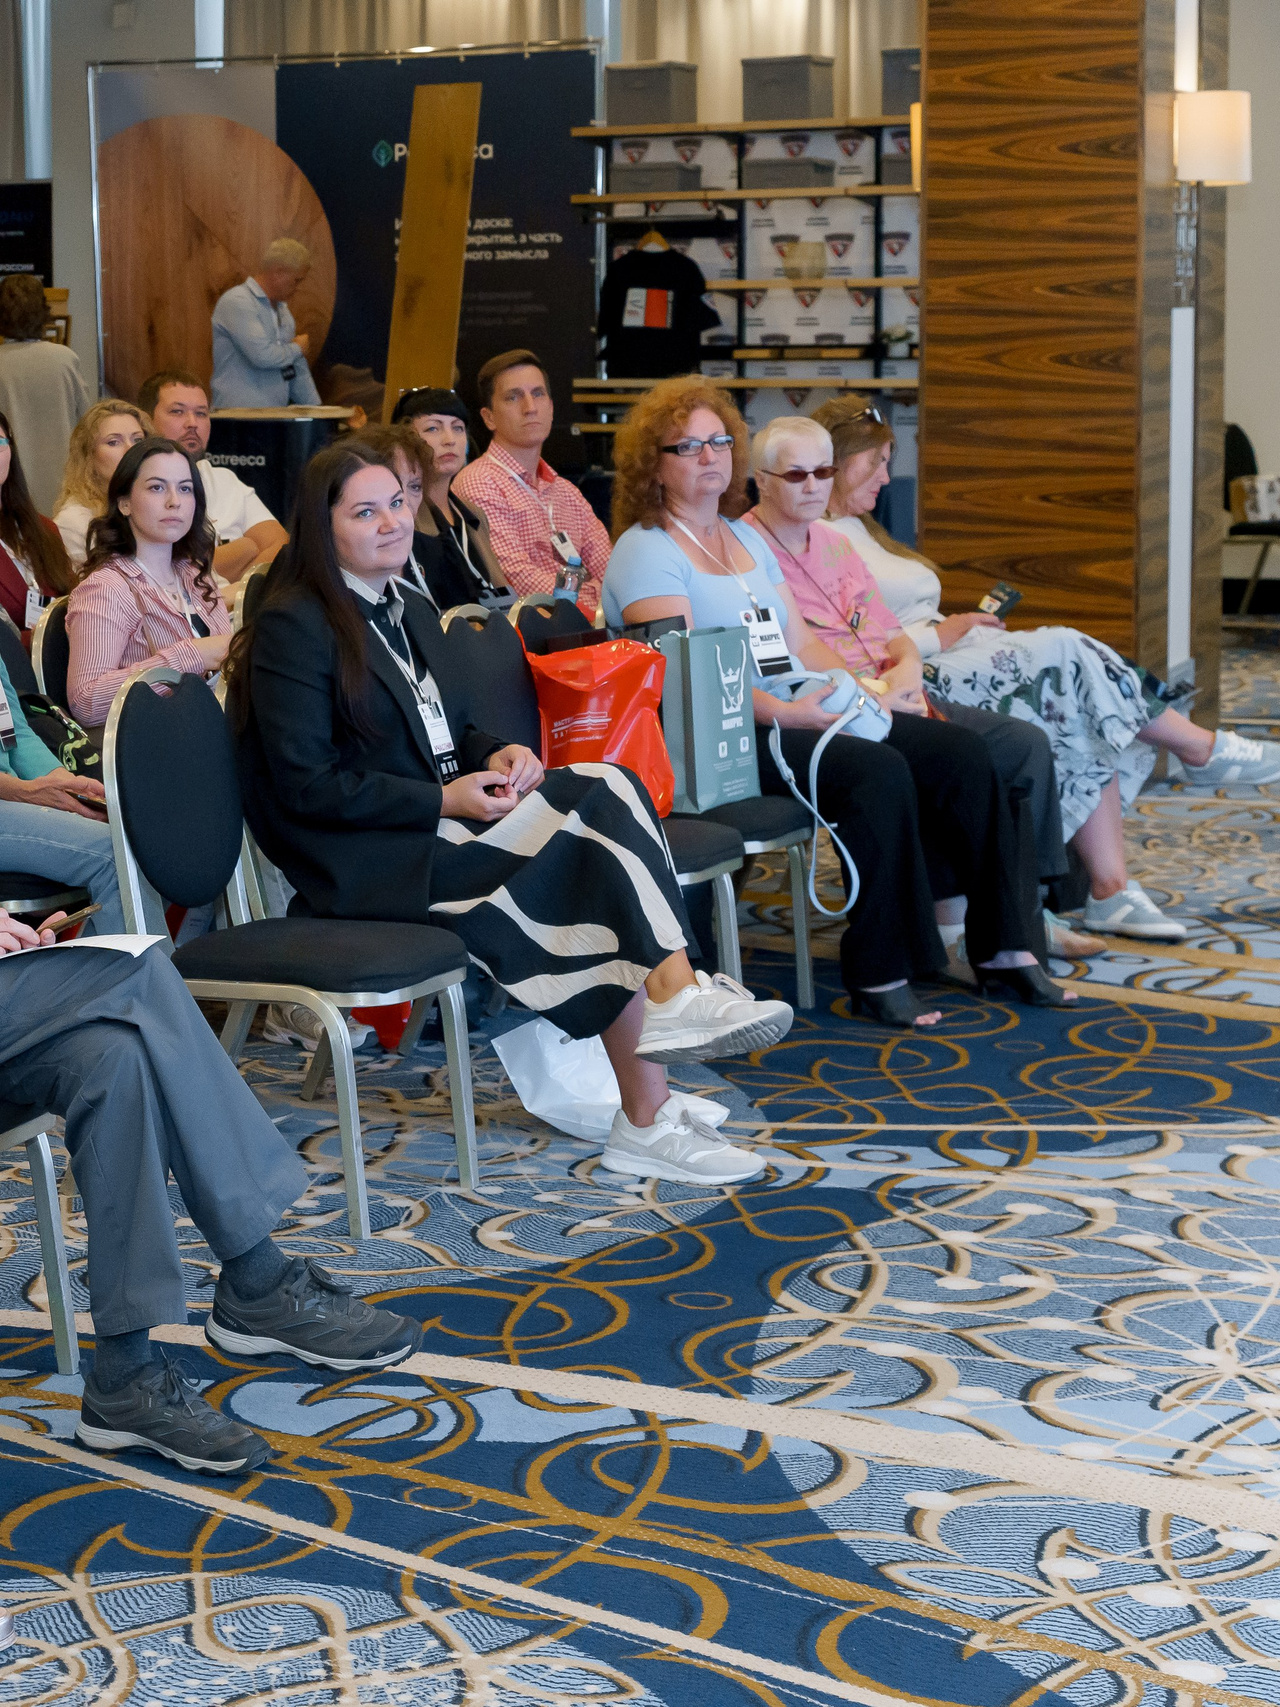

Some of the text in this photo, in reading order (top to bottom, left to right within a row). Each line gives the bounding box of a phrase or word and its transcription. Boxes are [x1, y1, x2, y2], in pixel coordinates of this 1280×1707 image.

[473, 218, 513, 230] доска:
[465, 234, 517, 246] окрытие,
[528, 233, 563, 244] часть
